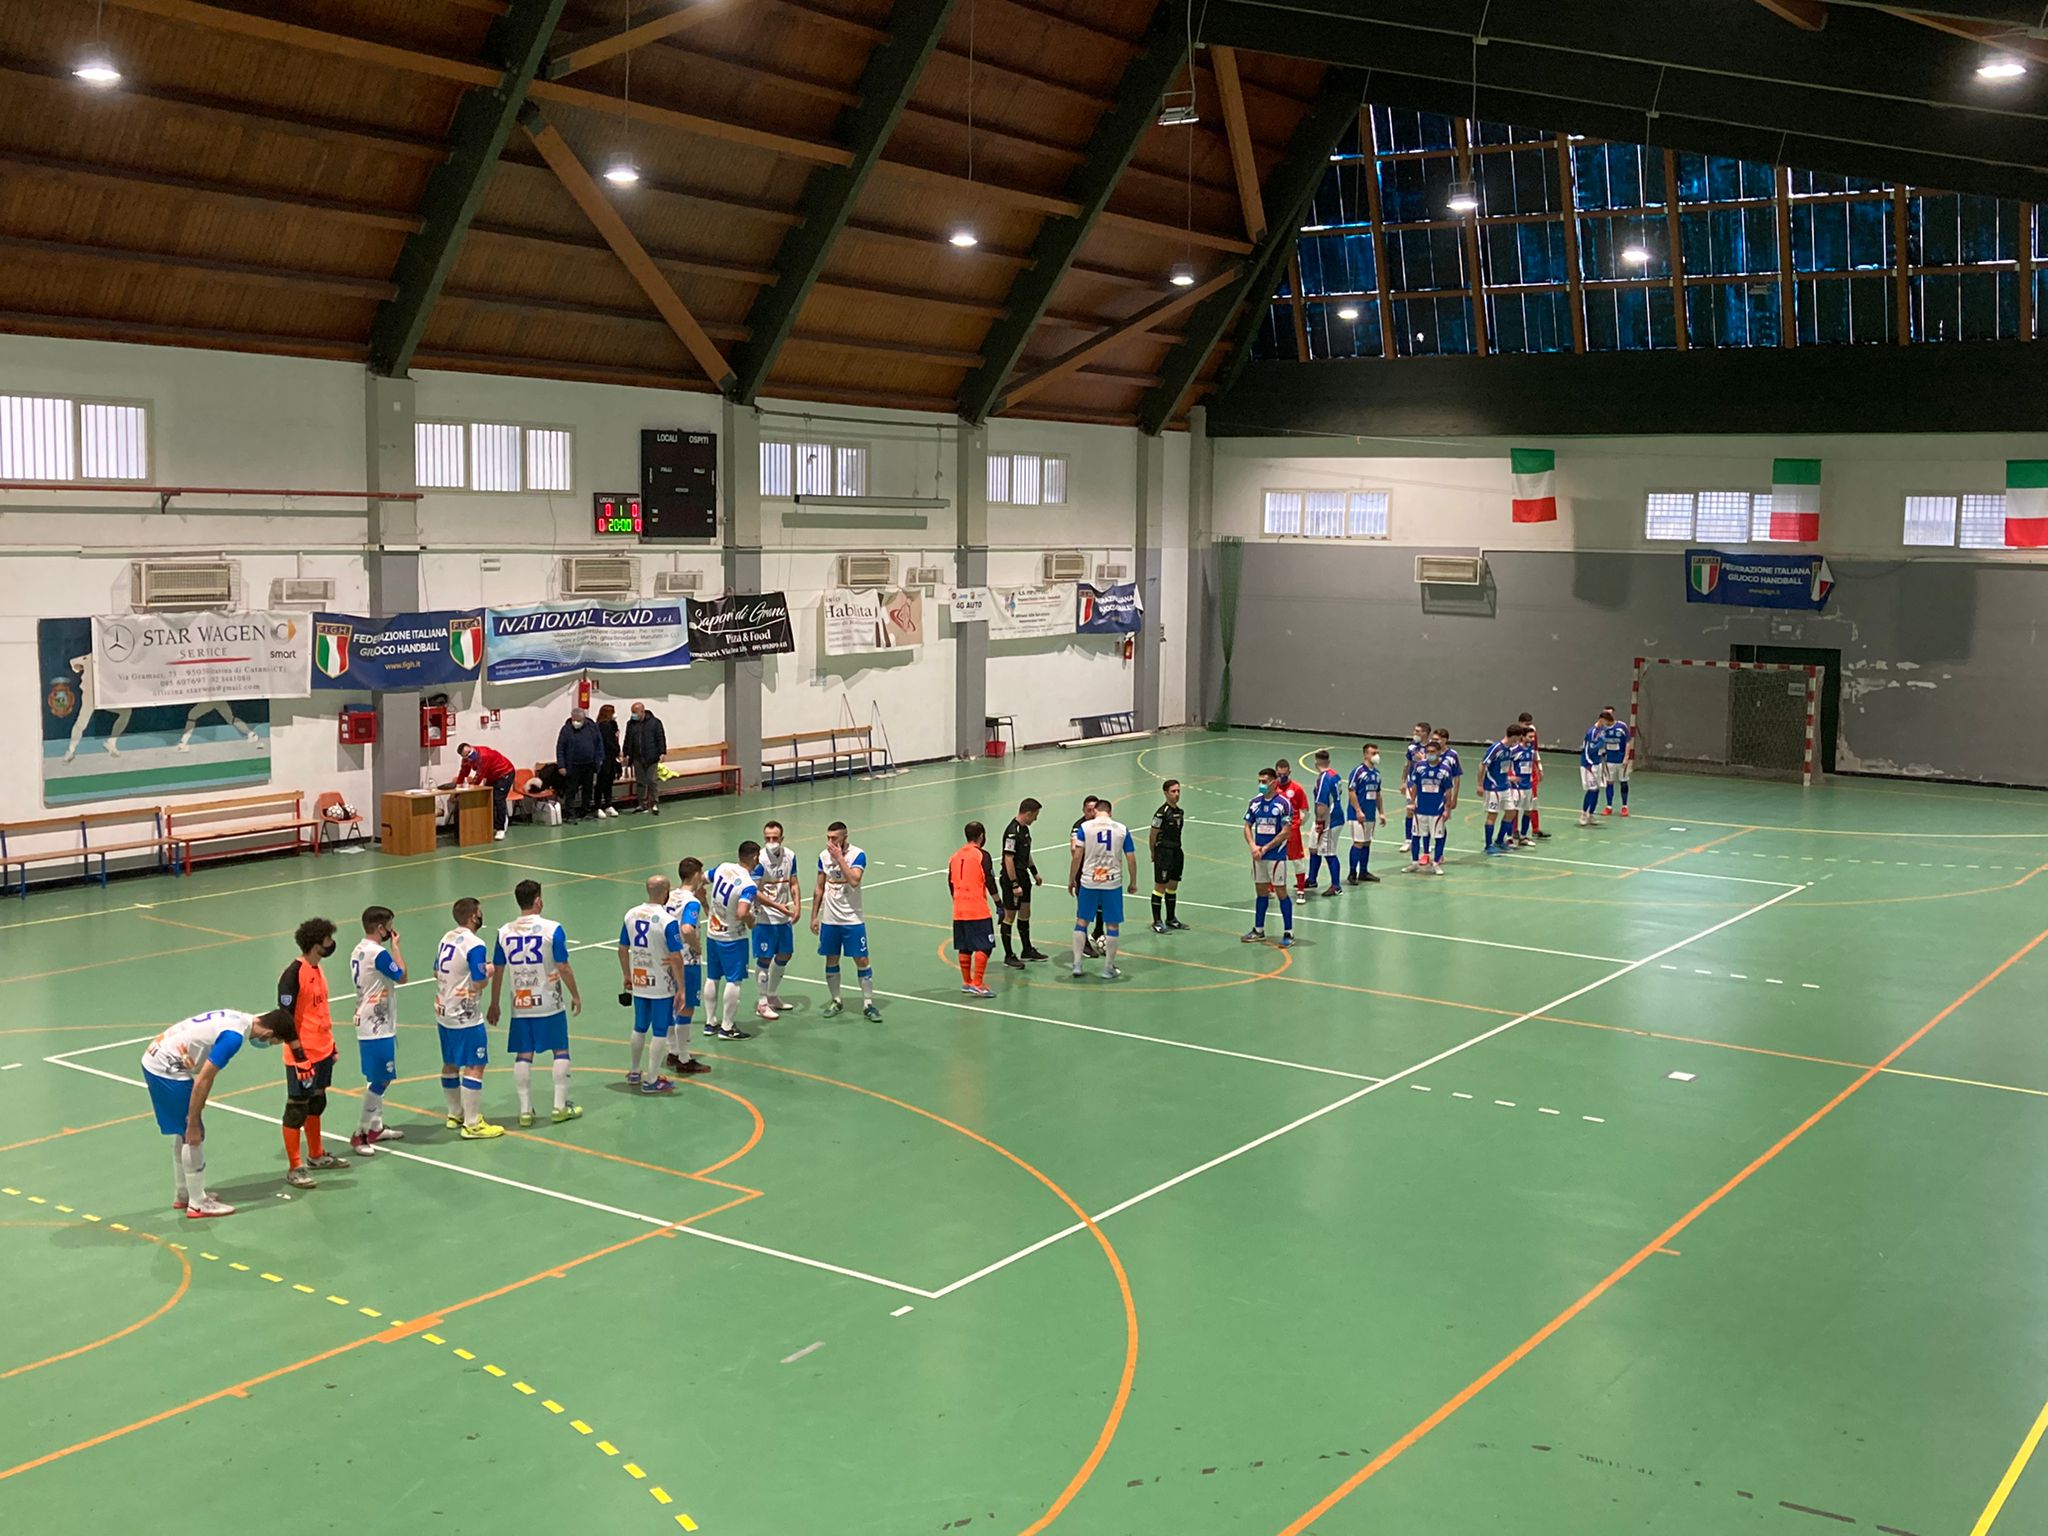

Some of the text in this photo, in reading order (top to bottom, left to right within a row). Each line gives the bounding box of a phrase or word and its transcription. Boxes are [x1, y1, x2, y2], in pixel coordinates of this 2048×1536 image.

[657, 434, 709, 444] LOCALI OSPITI
[605, 503, 612, 517] 0
[631, 503, 638, 517] 0
[598, 518, 606, 532] 0
[1721, 563, 1773, 575] FEDERAZIONE
[1774, 567, 1811, 576] ITALIANA
[1728, 575, 1803, 585] GIUOCO HANDBALL
[965, 601, 982, 609] AUTO
[735, 604, 750, 621] di
[499, 608, 596, 634] NATIONAL
[602, 609, 654, 625] FOND
[143, 624, 266, 647] STAR WAGEN
[411, 628, 448, 640] ITALIANA
[270, 650, 297, 659] smart
[359, 642, 440, 657] GIUOCO HANDBALL
[1096, 829, 1112, 851] 4
[713, 875, 734, 907] 14
[634, 919, 650, 948] 8
[505, 935, 543, 965] 23
